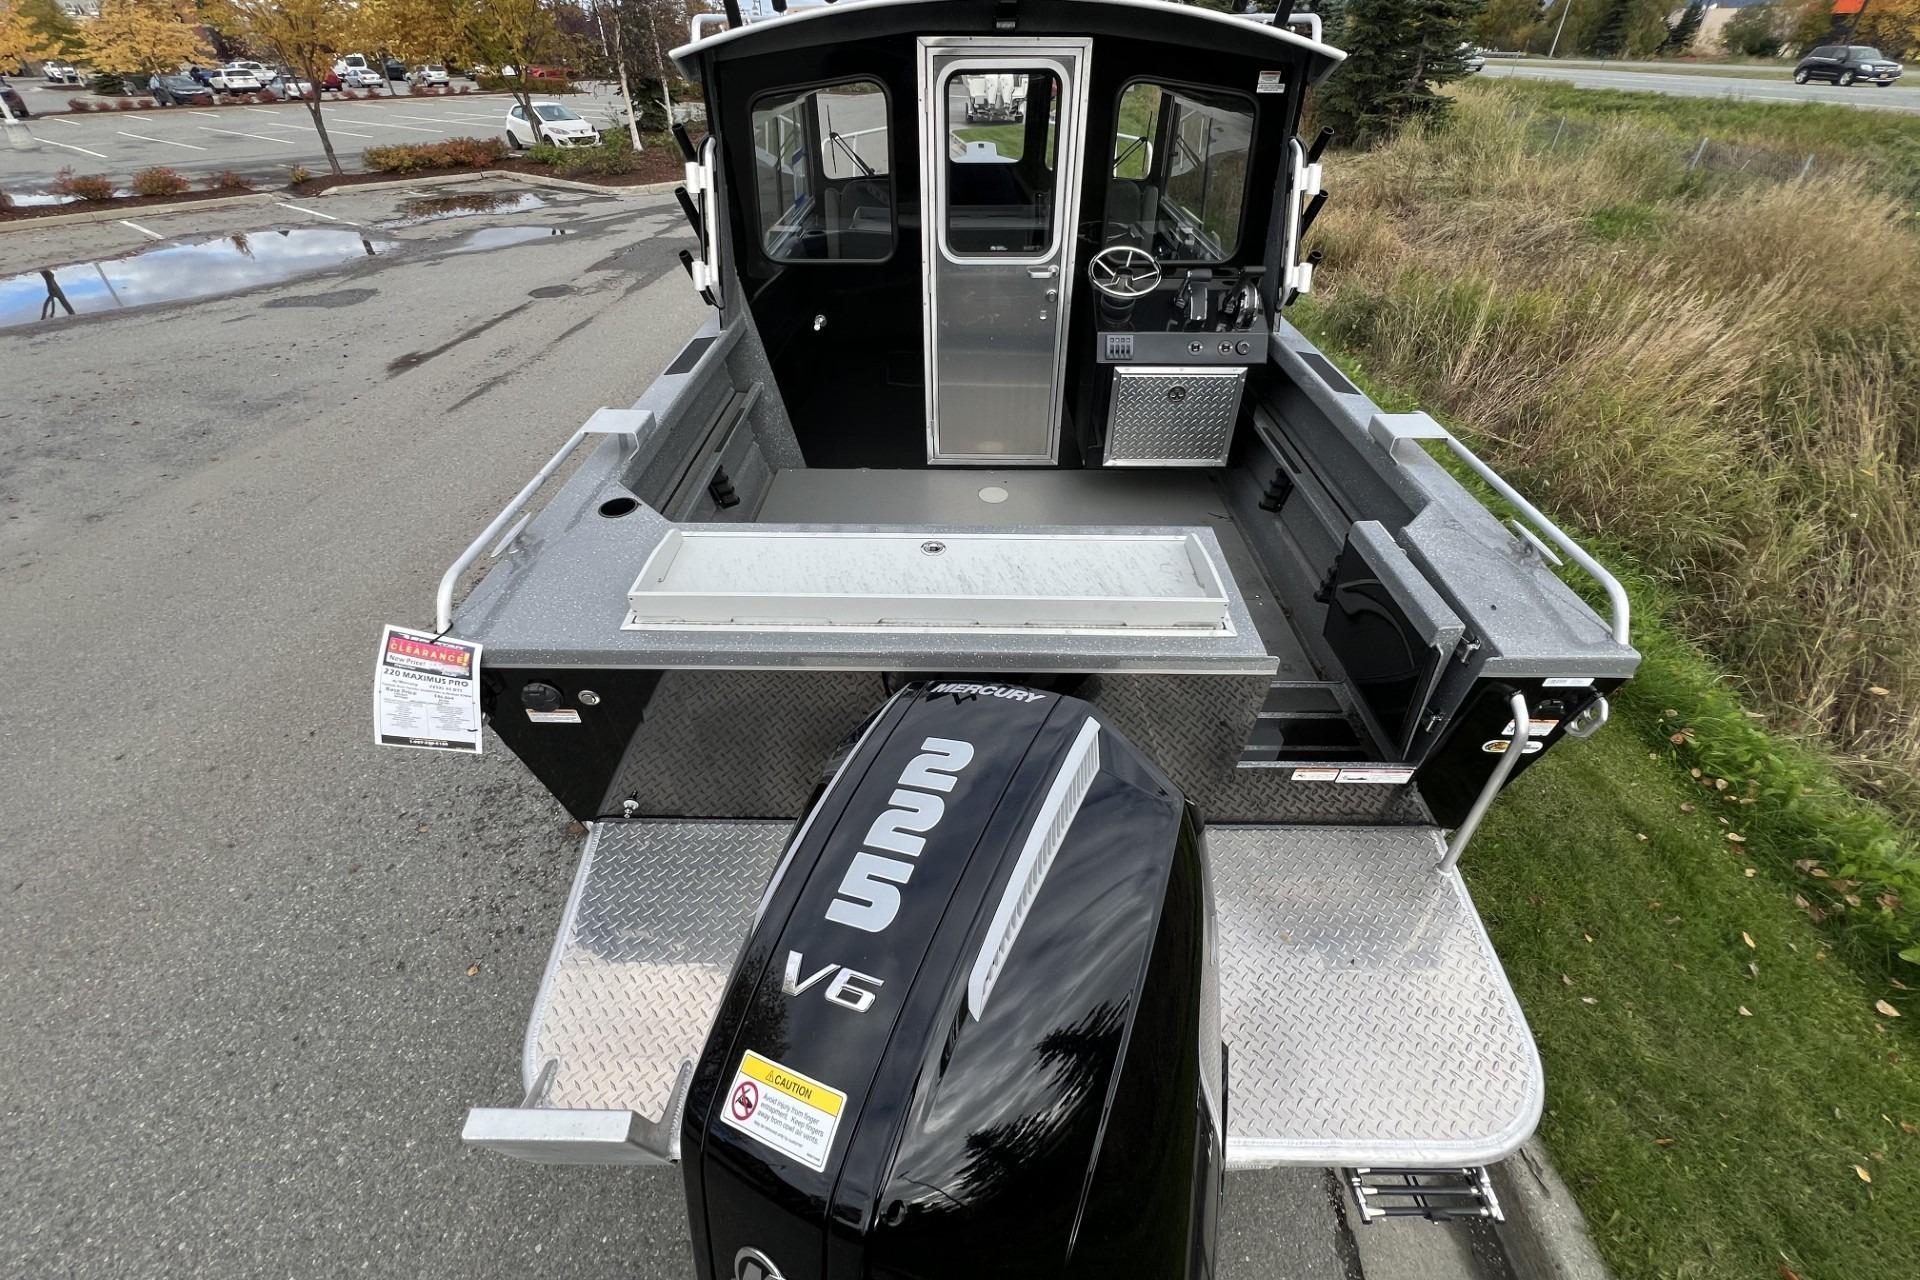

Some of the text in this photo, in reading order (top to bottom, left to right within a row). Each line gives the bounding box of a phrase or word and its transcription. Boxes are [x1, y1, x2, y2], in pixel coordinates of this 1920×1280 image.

[389, 654, 405, 663] New
[390, 642, 470, 667] CLEARANCE!
[383, 668, 400, 676] 220
[402, 672, 446, 685] MAXIMUS
[448, 679, 469, 688] PRO
[930, 683, 1047, 703] MERCURY
[824, 736, 975, 933] 225
[781, 949, 885, 1013] V6
[774, 1074, 813, 1100] CAUTION
[757, 1110, 771, 1122] away
[771, 1115, 783, 1127] from
[763, 1092, 820, 1126] Avoid injury from finger
[790, 1116, 805, 1129] Keep
[805, 1122, 824, 1138] fingers
